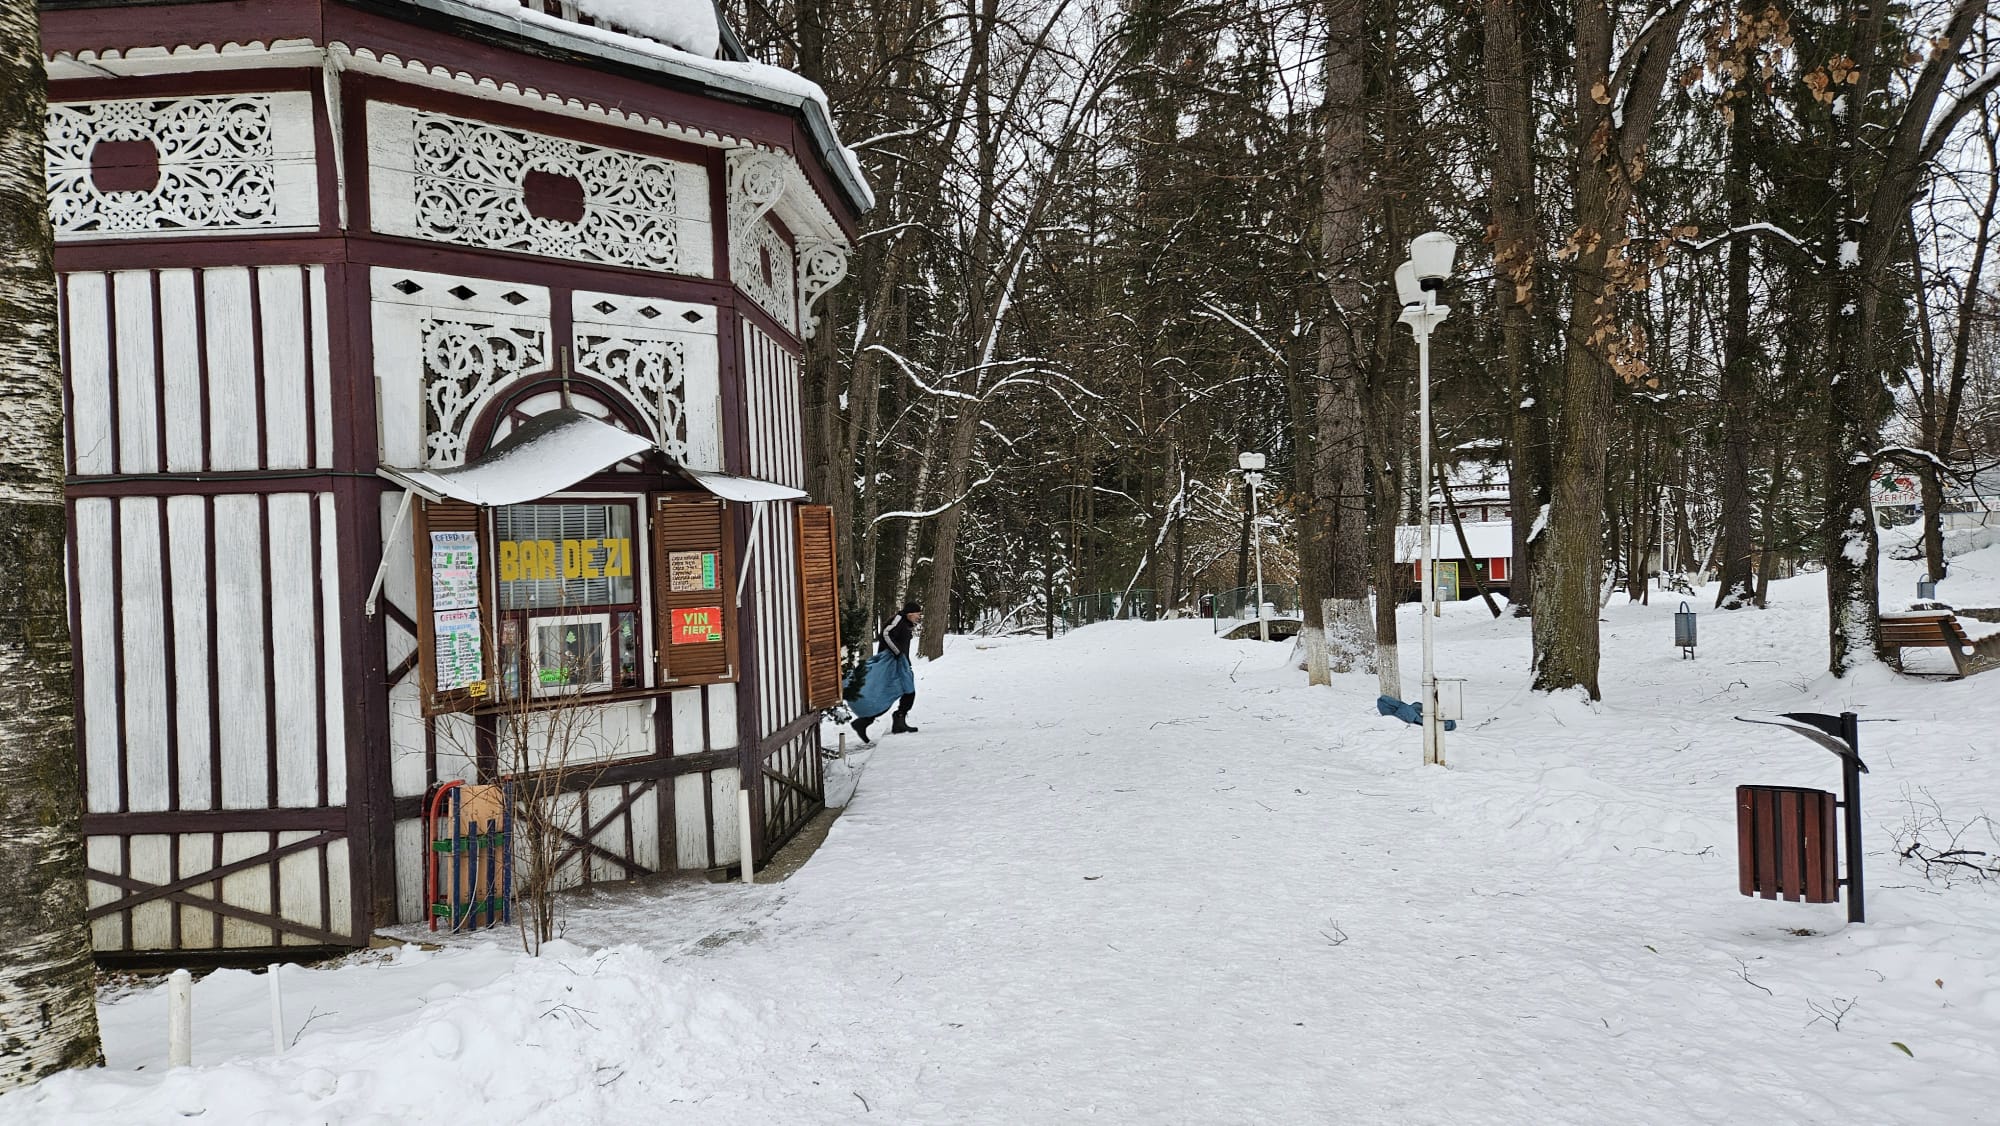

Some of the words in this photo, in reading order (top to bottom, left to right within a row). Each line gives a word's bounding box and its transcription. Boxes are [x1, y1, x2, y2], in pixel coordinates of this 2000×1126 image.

[500, 540, 556, 581] BAR
[683, 612, 708, 625] VIN
[682, 625, 713, 635] FIERT
